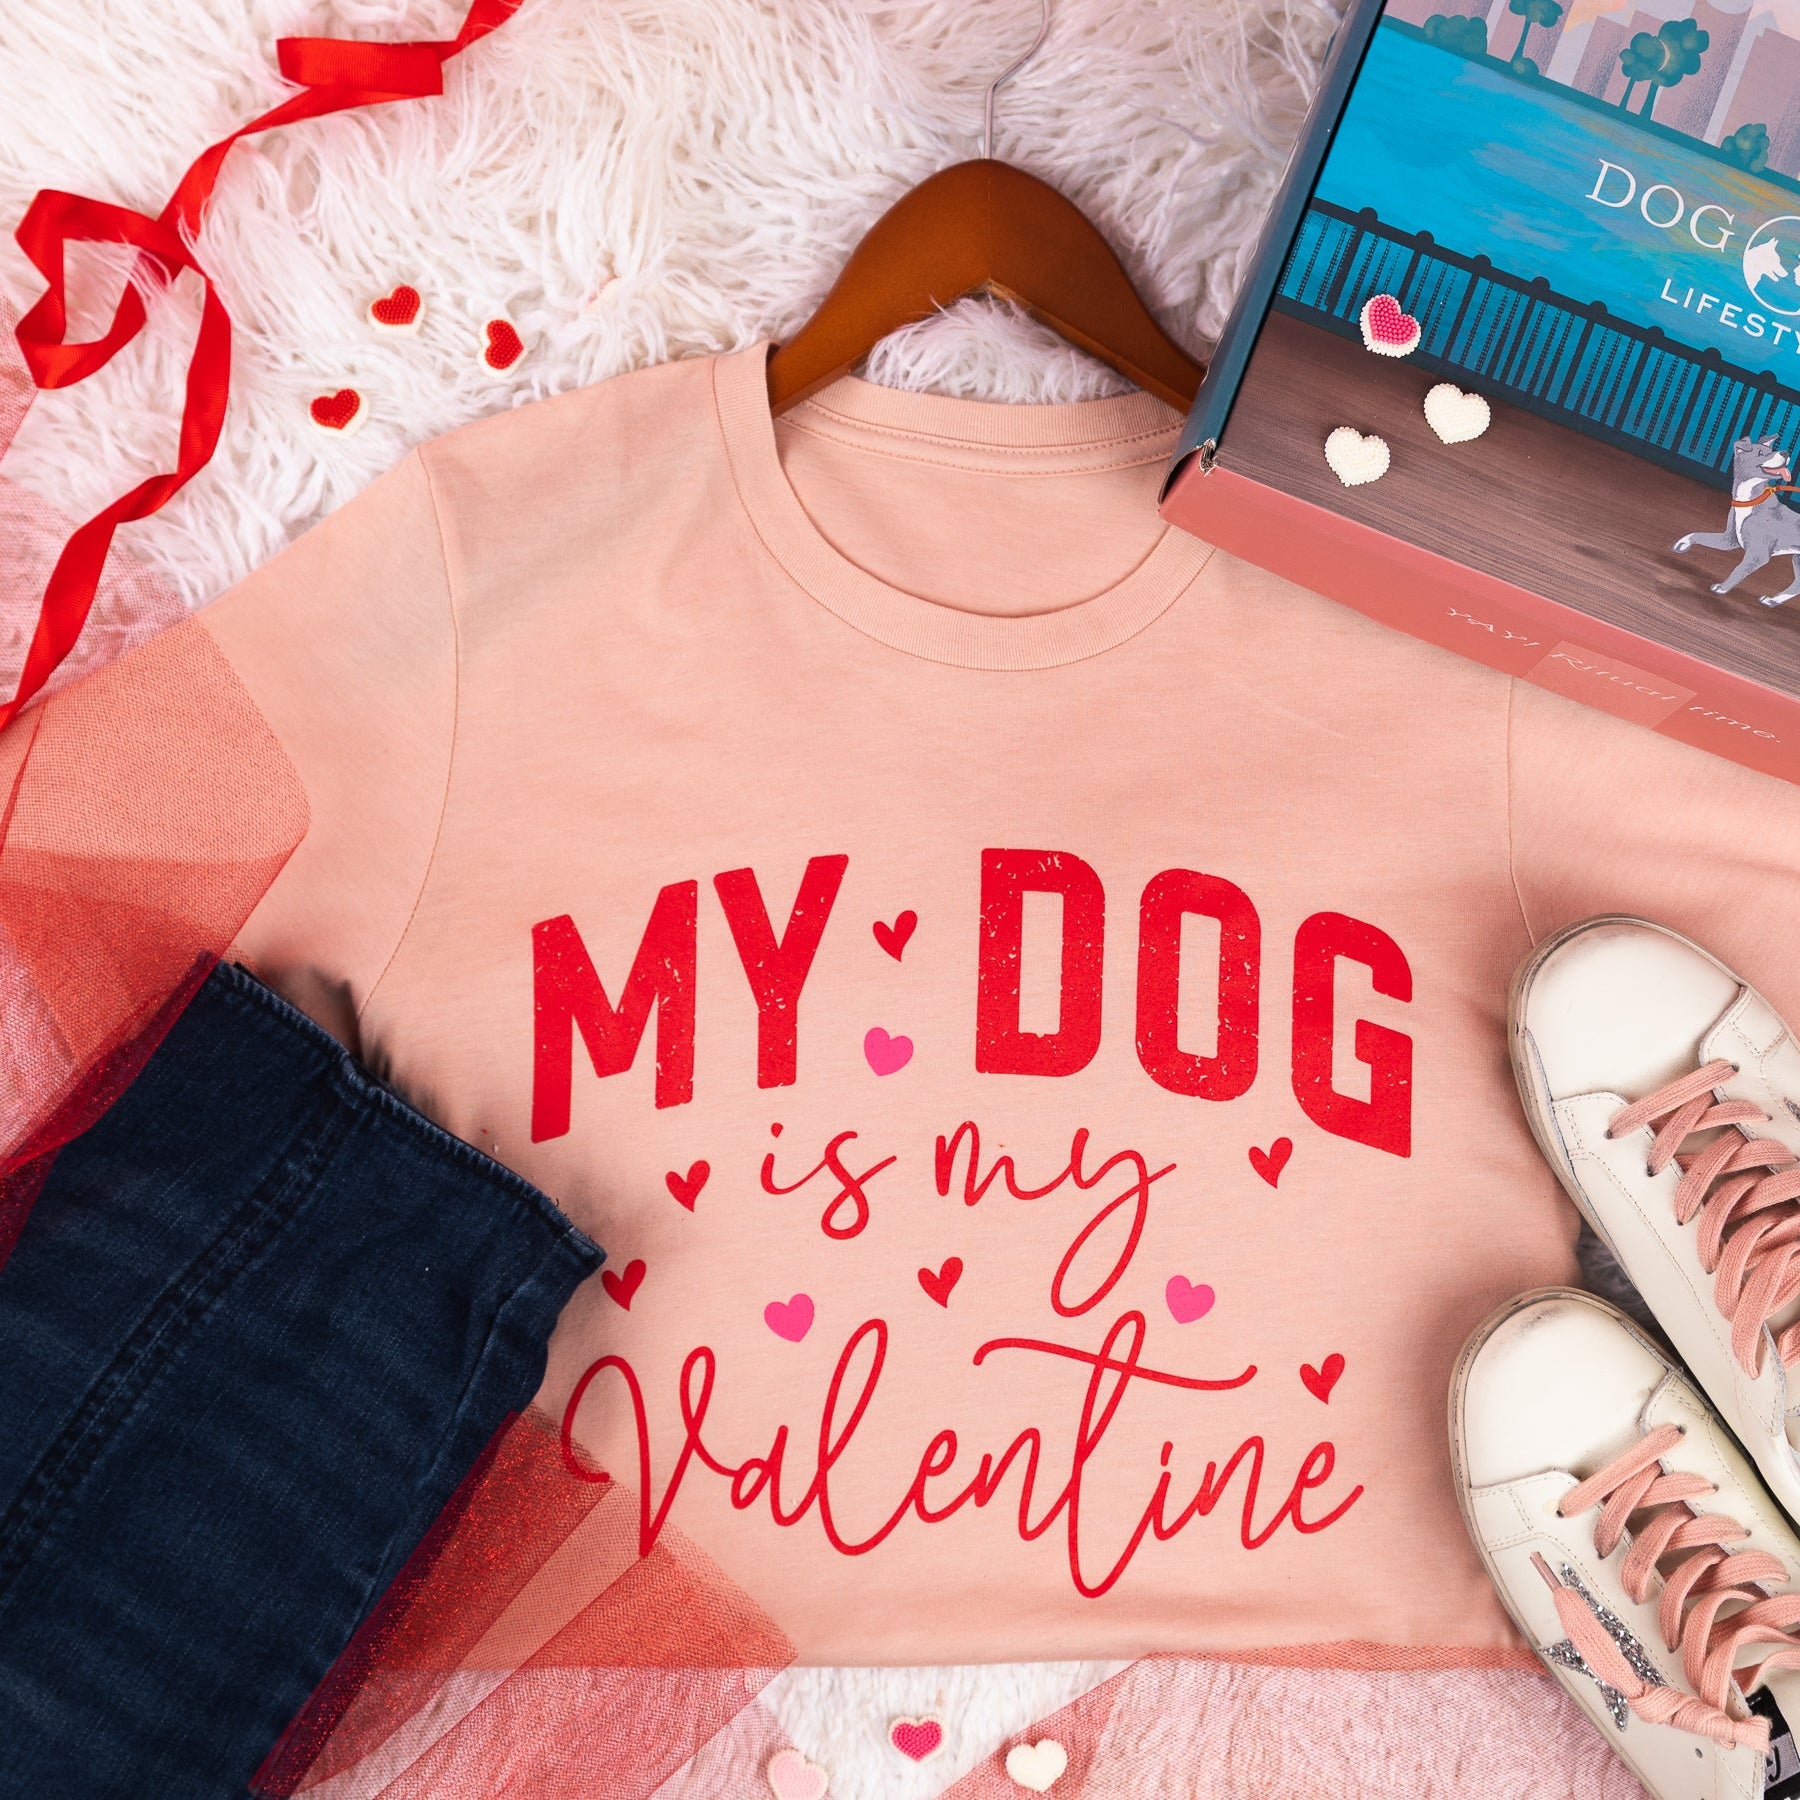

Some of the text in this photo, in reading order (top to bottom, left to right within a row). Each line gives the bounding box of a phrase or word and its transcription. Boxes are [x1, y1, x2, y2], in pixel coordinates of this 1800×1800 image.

[1585, 158, 1735, 253] DOG
[1550, 652, 1676, 701] Ritual
[531, 854, 849, 1143] MY
[975, 848, 1413, 1158] DOG
[760, 1121, 1176, 1317] is my
[561, 1310, 1364, 1598] Valentine
